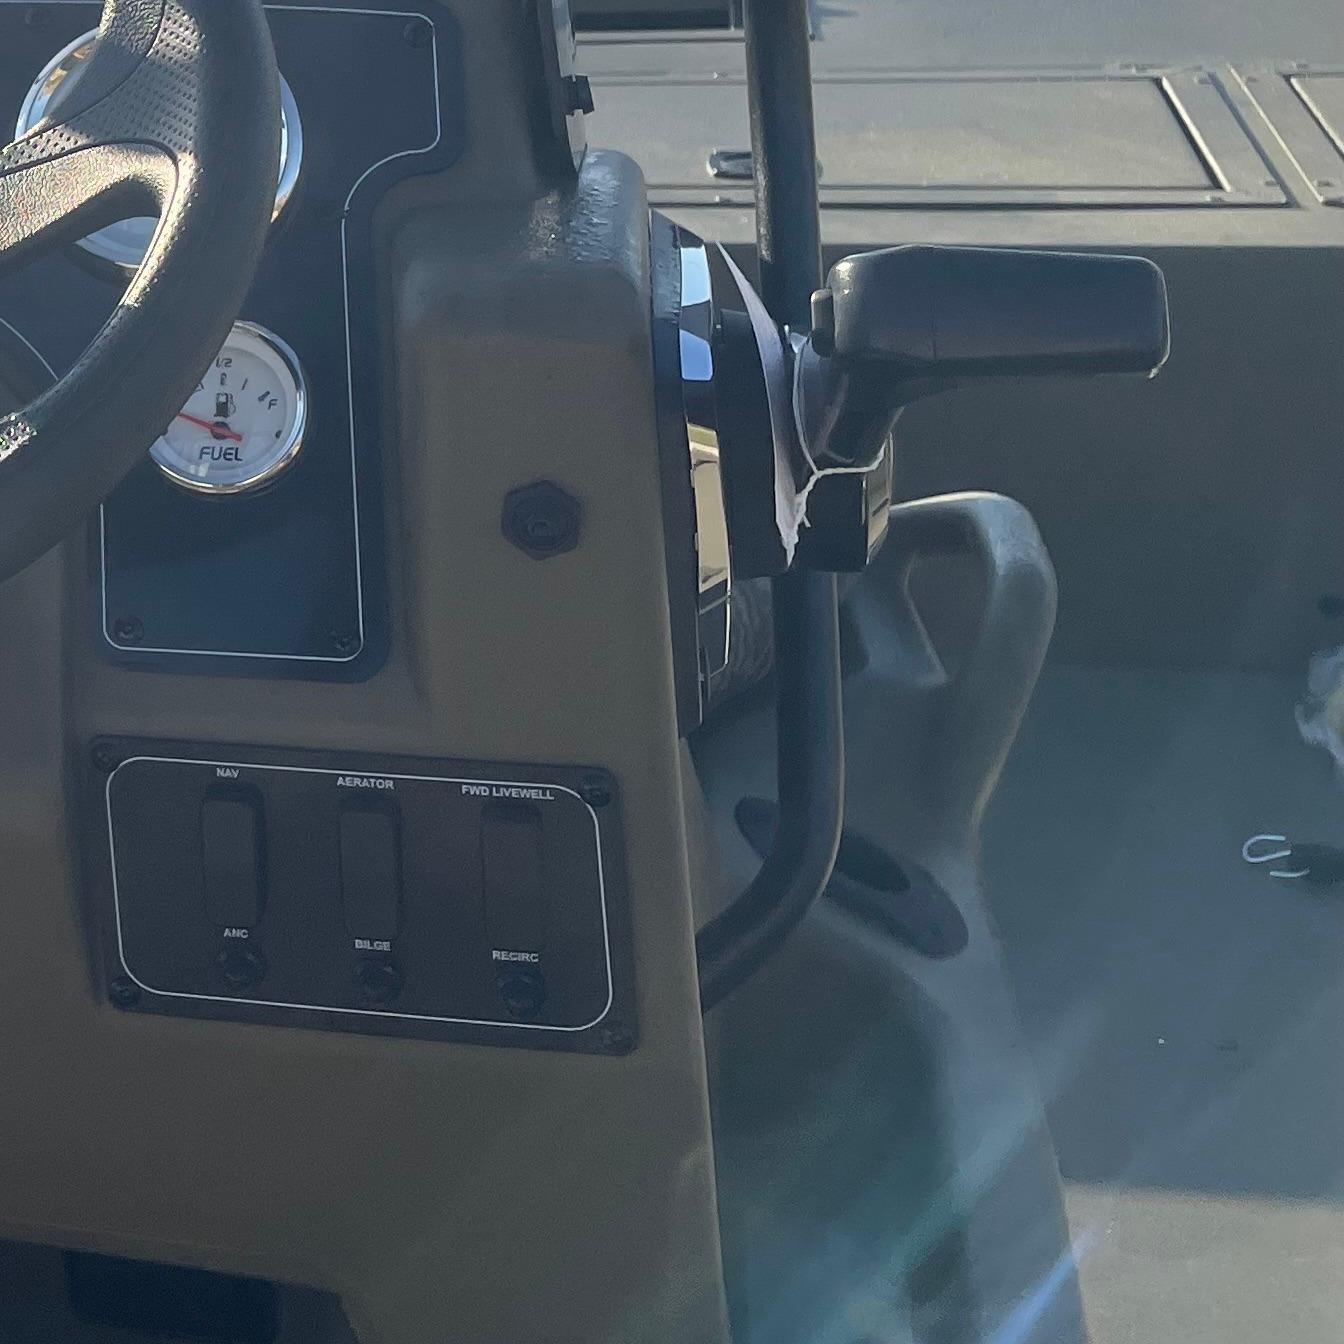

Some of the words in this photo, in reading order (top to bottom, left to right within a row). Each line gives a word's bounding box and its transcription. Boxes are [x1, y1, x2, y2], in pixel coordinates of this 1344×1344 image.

[268, 399, 278, 410] F
[199, 446, 243, 462] FUEL
[216, 767, 240, 779] NAV
[337, 776, 394, 790] AERATOR
[461, 784, 490, 796] FWD
[492, 786, 555, 801] LIVEWELL
[223, 927, 249, 939] ANC
[355, 938, 391, 952] BILGE
[492, 950, 539, 963] RECIRC
